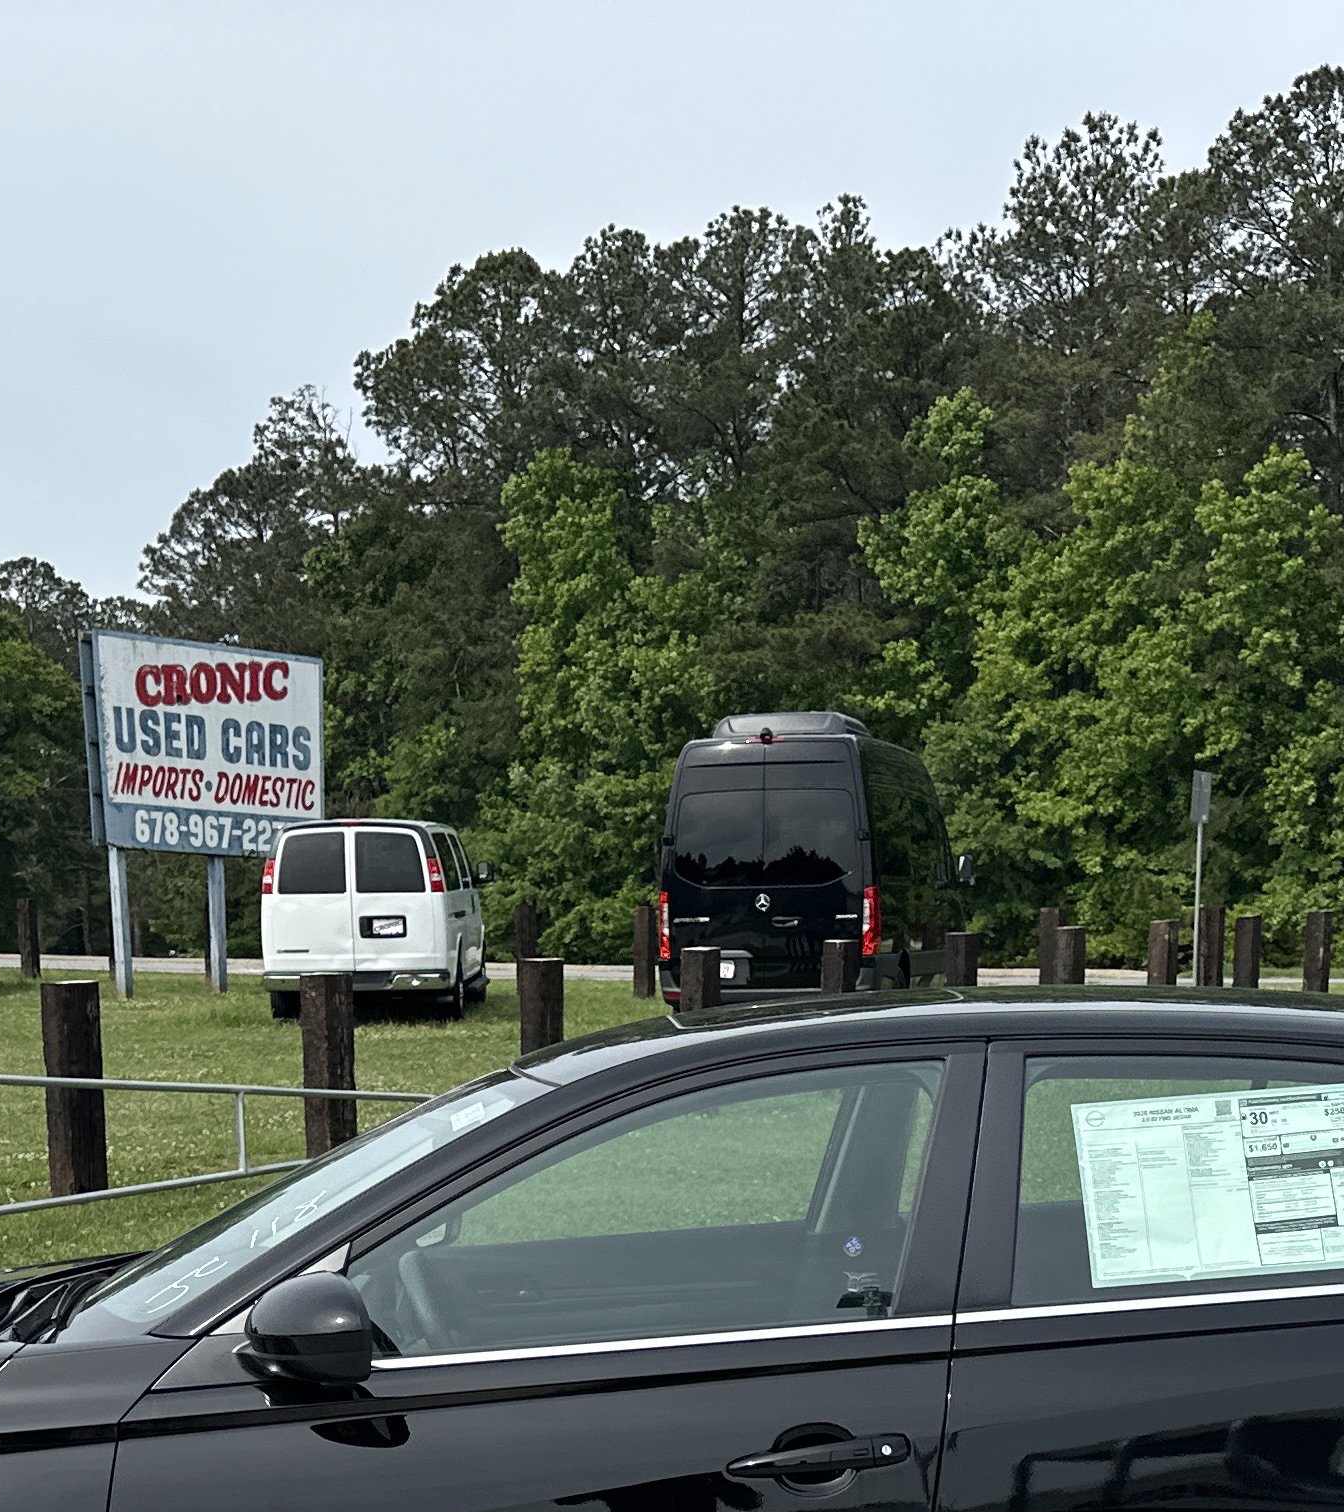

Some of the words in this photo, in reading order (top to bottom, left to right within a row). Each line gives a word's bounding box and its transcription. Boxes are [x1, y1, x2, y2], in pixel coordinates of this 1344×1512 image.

[135, 660, 289, 707] CRONIC
[113, 706, 206, 761] USED
[220, 717, 312, 771] CARS
[113, 761, 204, 801] IMPORTS
[213, 770, 316, 811] DOMESTIC
[134, 809, 283, 850] 678-967-22
[1248, 1111, 1268, 1125] 30
